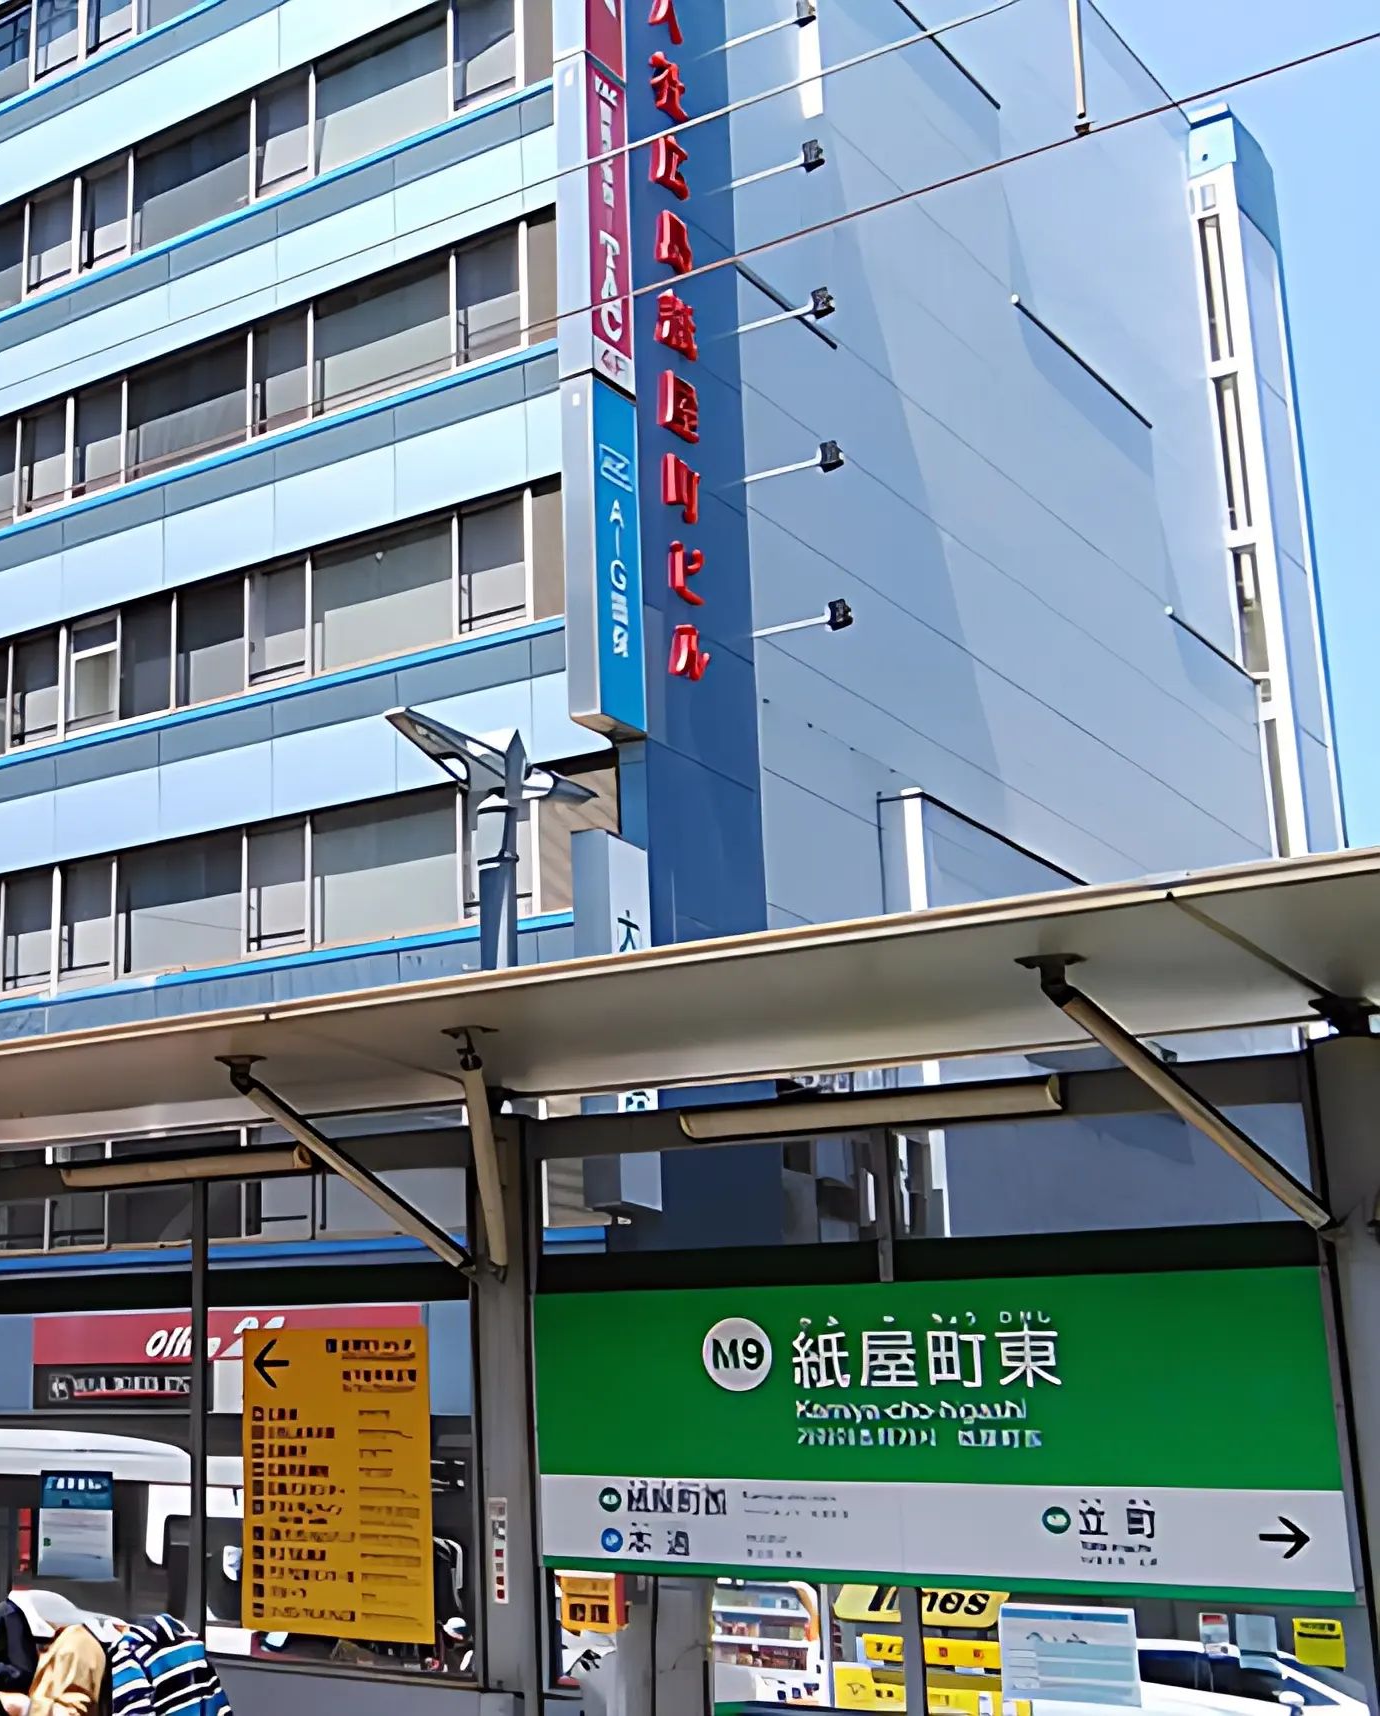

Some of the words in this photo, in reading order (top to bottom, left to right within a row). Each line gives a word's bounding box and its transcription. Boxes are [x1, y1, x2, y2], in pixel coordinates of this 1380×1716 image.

[599, 229, 623, 342] TAC
[711, 1337, 765, 1371] M9
[791, 1326, 1062, 1389] 紙屋町東
